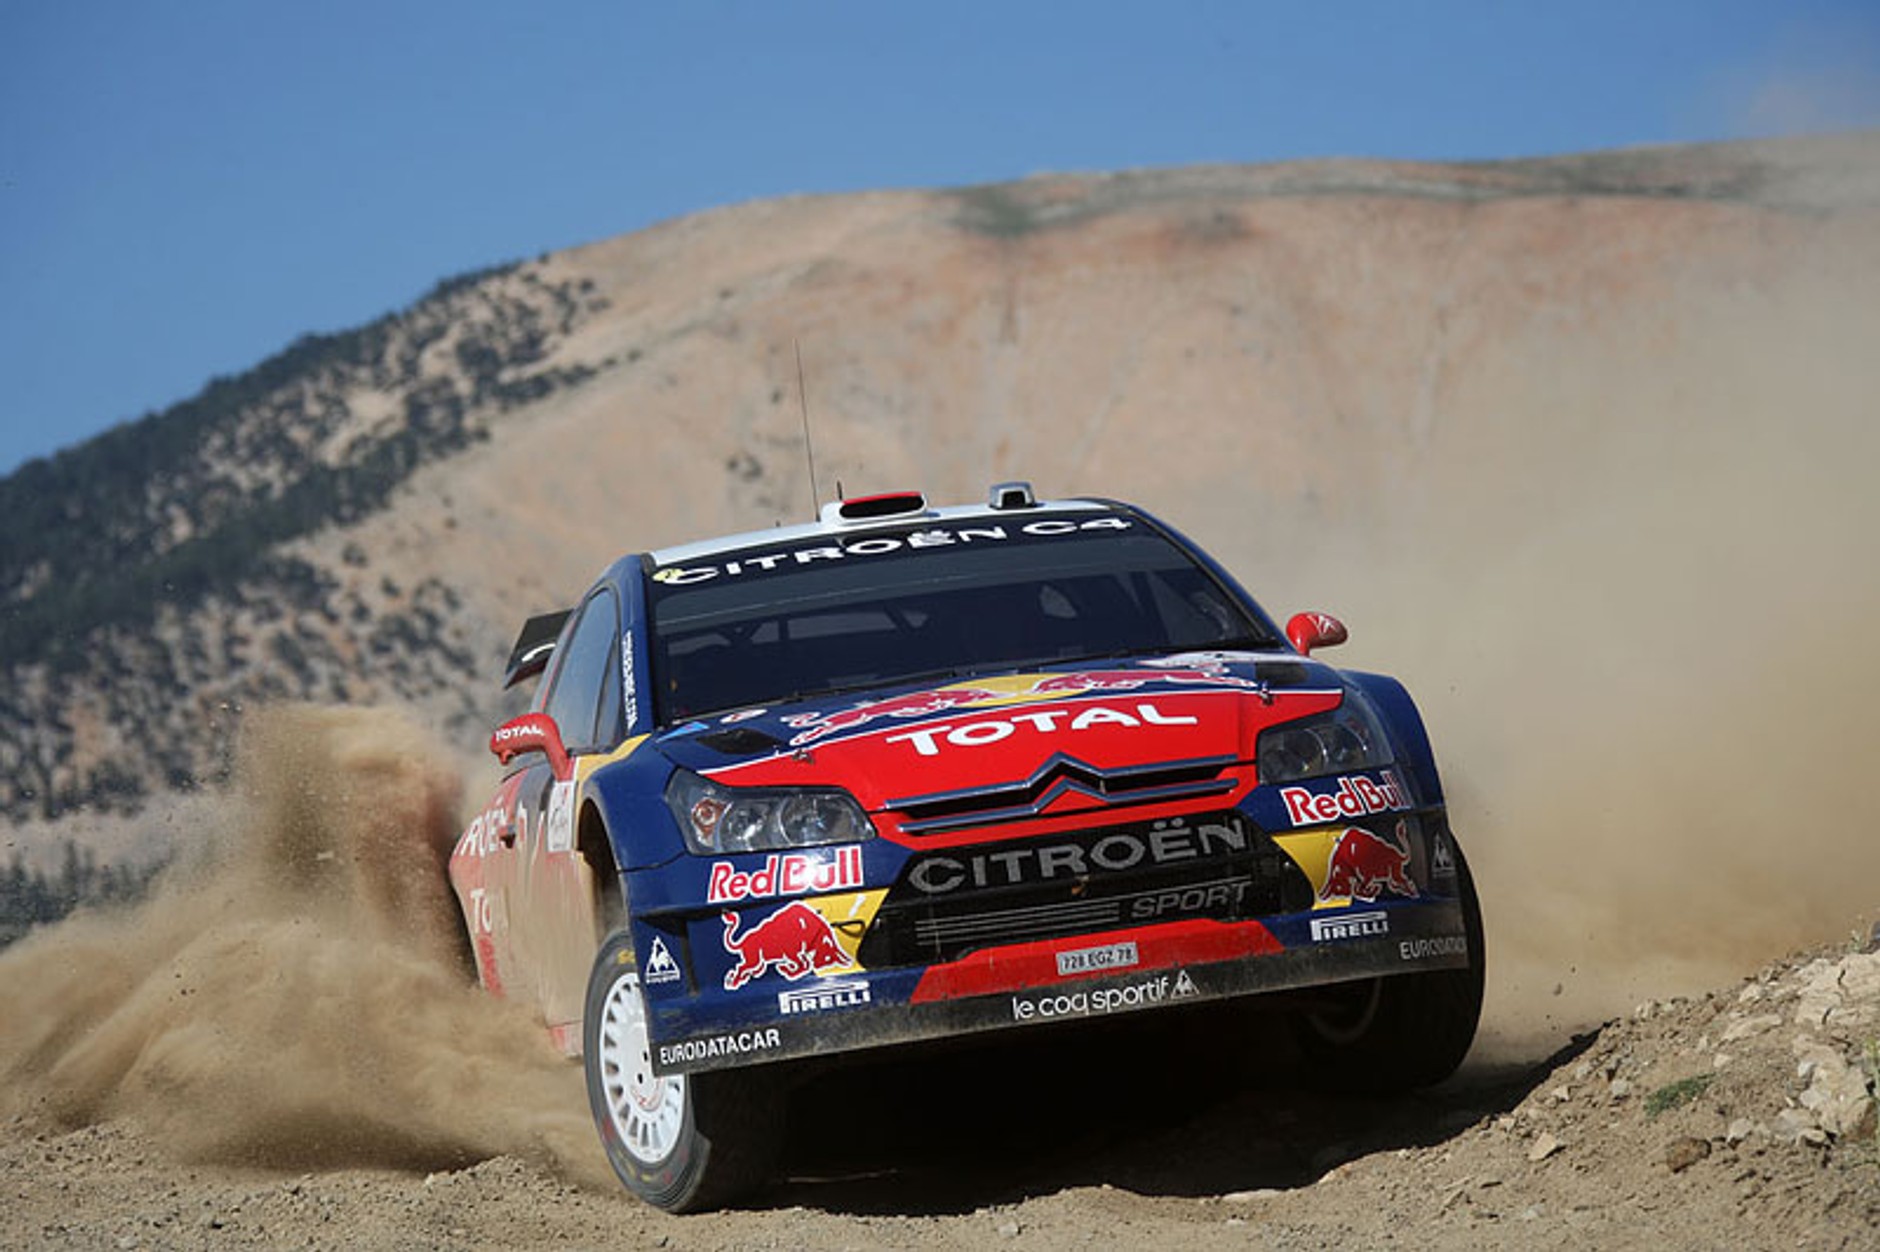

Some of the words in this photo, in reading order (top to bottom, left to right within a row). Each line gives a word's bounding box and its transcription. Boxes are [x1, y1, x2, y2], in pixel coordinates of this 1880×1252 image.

[1022, 518, 1132, 535] C4
[495, 724, 545, 742] TOTAL
[886, 704, 1198, 756] TOTAL
[1280, 777, 1366, 827] Red
[707, 855, 779, 903] Red
[778, 845, 864, 895] Bull
[908, 817, 1246, 893] CITROËN
[1130, 881, 1252, 919] SPORT
[1310, 911, 1389, 941] PIRELLI
[778, 980, 871, 1014] PIRELLI
[1013, 997, 1035, 1020] le
[1038, 993, 1089, 1016] coq
[1092, 976, 1168, 1013] sportif
[660, 1028, 781, 1065] EURODATACAR
